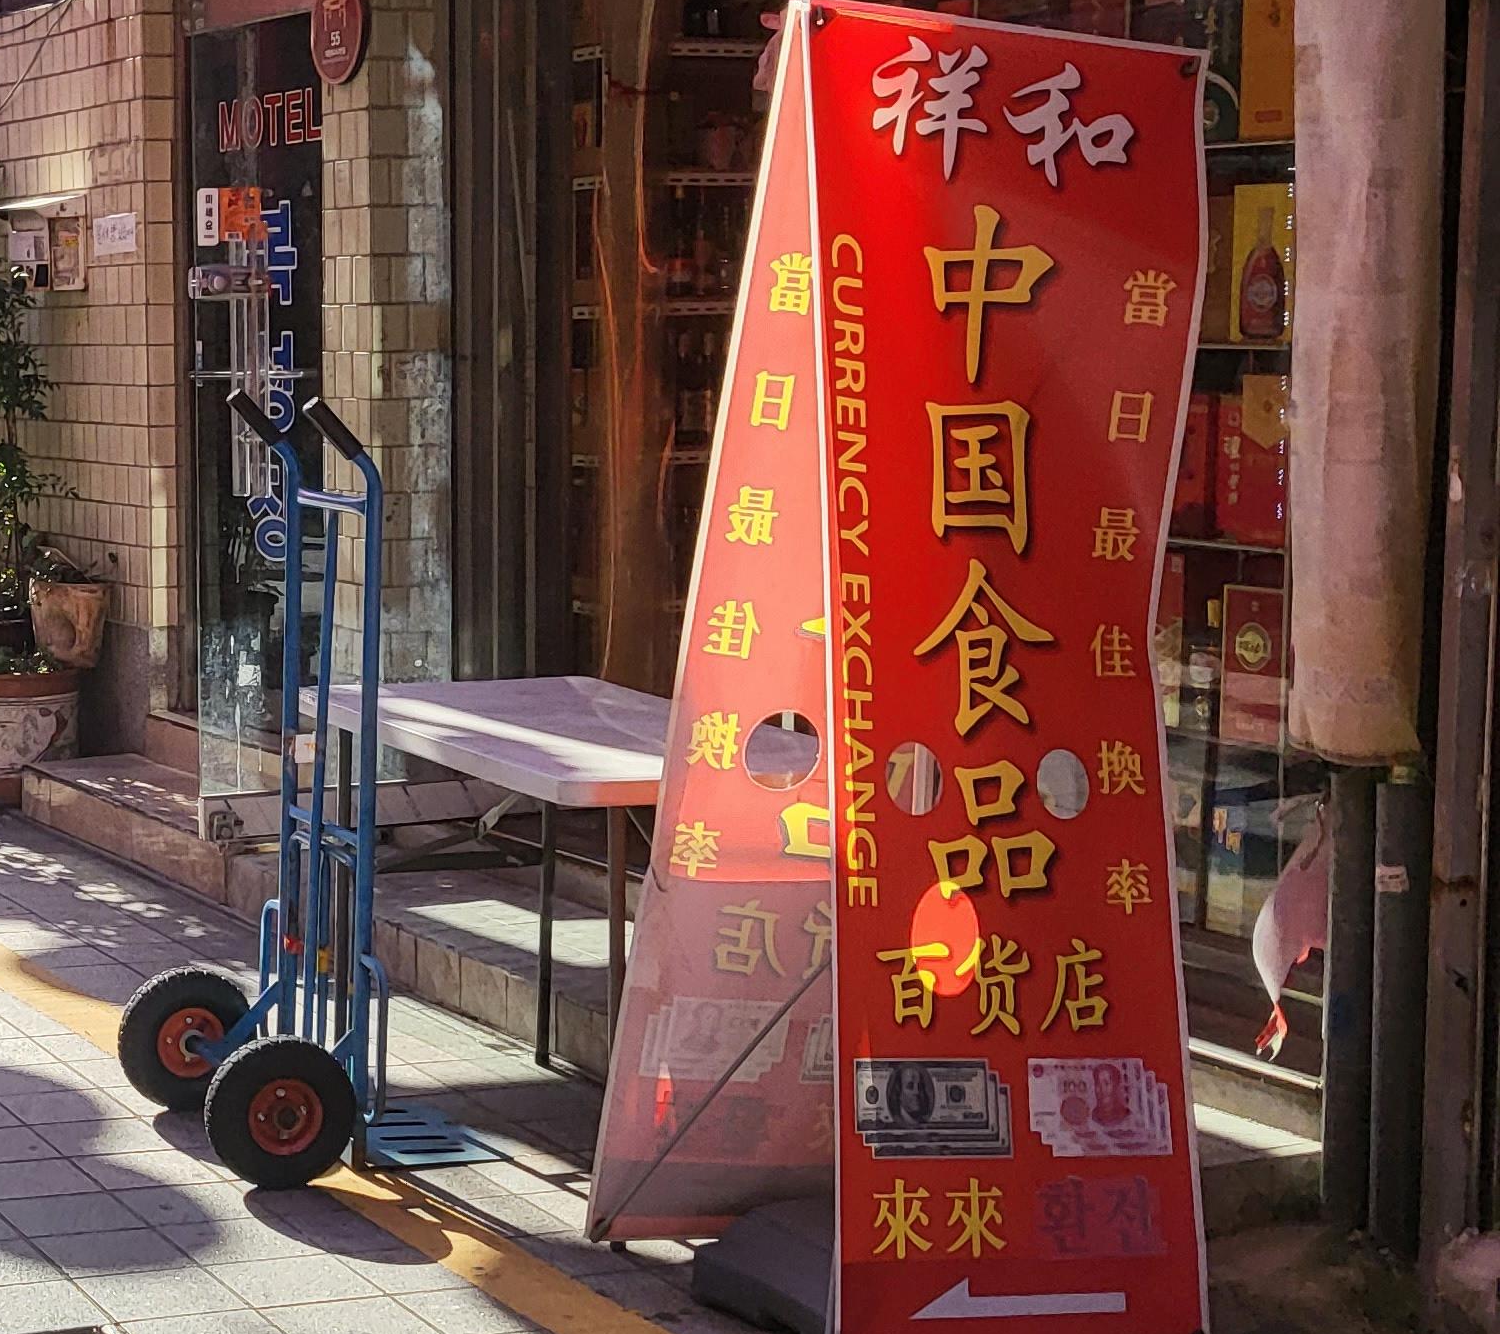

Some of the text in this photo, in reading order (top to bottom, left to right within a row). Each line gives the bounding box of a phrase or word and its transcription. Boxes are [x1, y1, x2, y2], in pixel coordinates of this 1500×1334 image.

[331, 31, 340, 46] 55
[217, 86, 322, 153] MOTEL
[871, 36, 1136, 186] 祥和
[831, 234, 880, 909] CURRENCY EXCHANGE
[913, 204, 1057, 900] 中国食品
[876, 936, 1108, 1037] 百货店
[872, 1178, 1008, 1260] 來來
